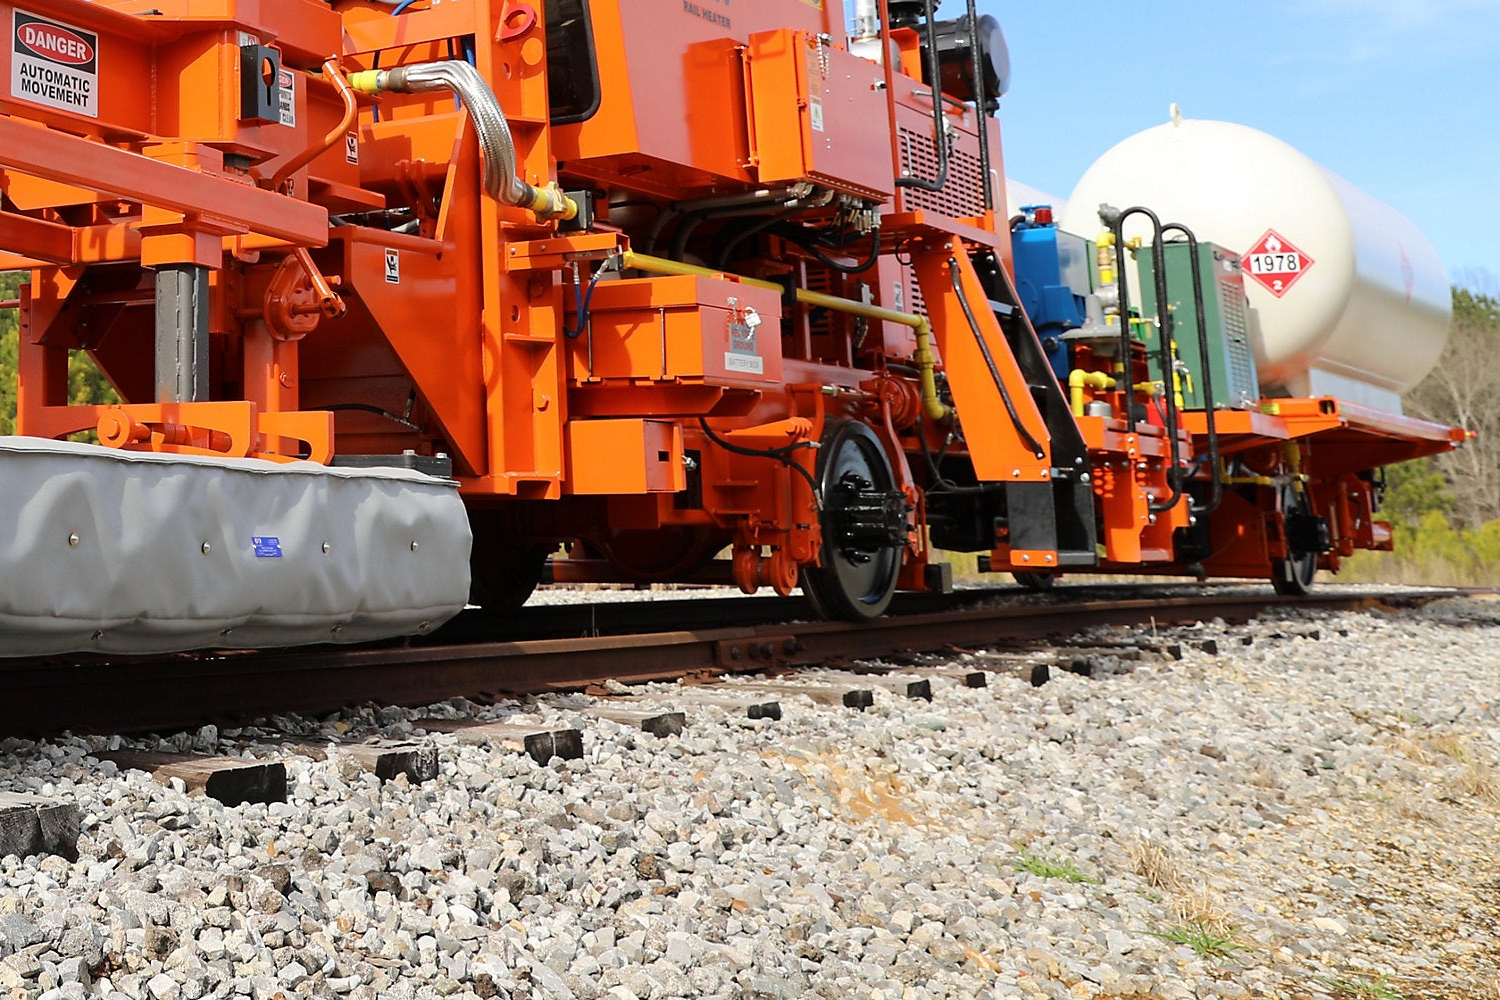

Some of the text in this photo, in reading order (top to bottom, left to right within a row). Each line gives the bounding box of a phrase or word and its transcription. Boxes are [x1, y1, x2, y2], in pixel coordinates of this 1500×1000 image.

[683, 0, 731, 29] RAIL HEATER
[25, 27, 87, 60] DANGER
[20, 62, 90, 93] AUTOMATIC
[21, 78, 89, 107] MOVEMENT
[1253, 254, 1297, 272] 1978
[1272, 280, 1283, 290] 2
